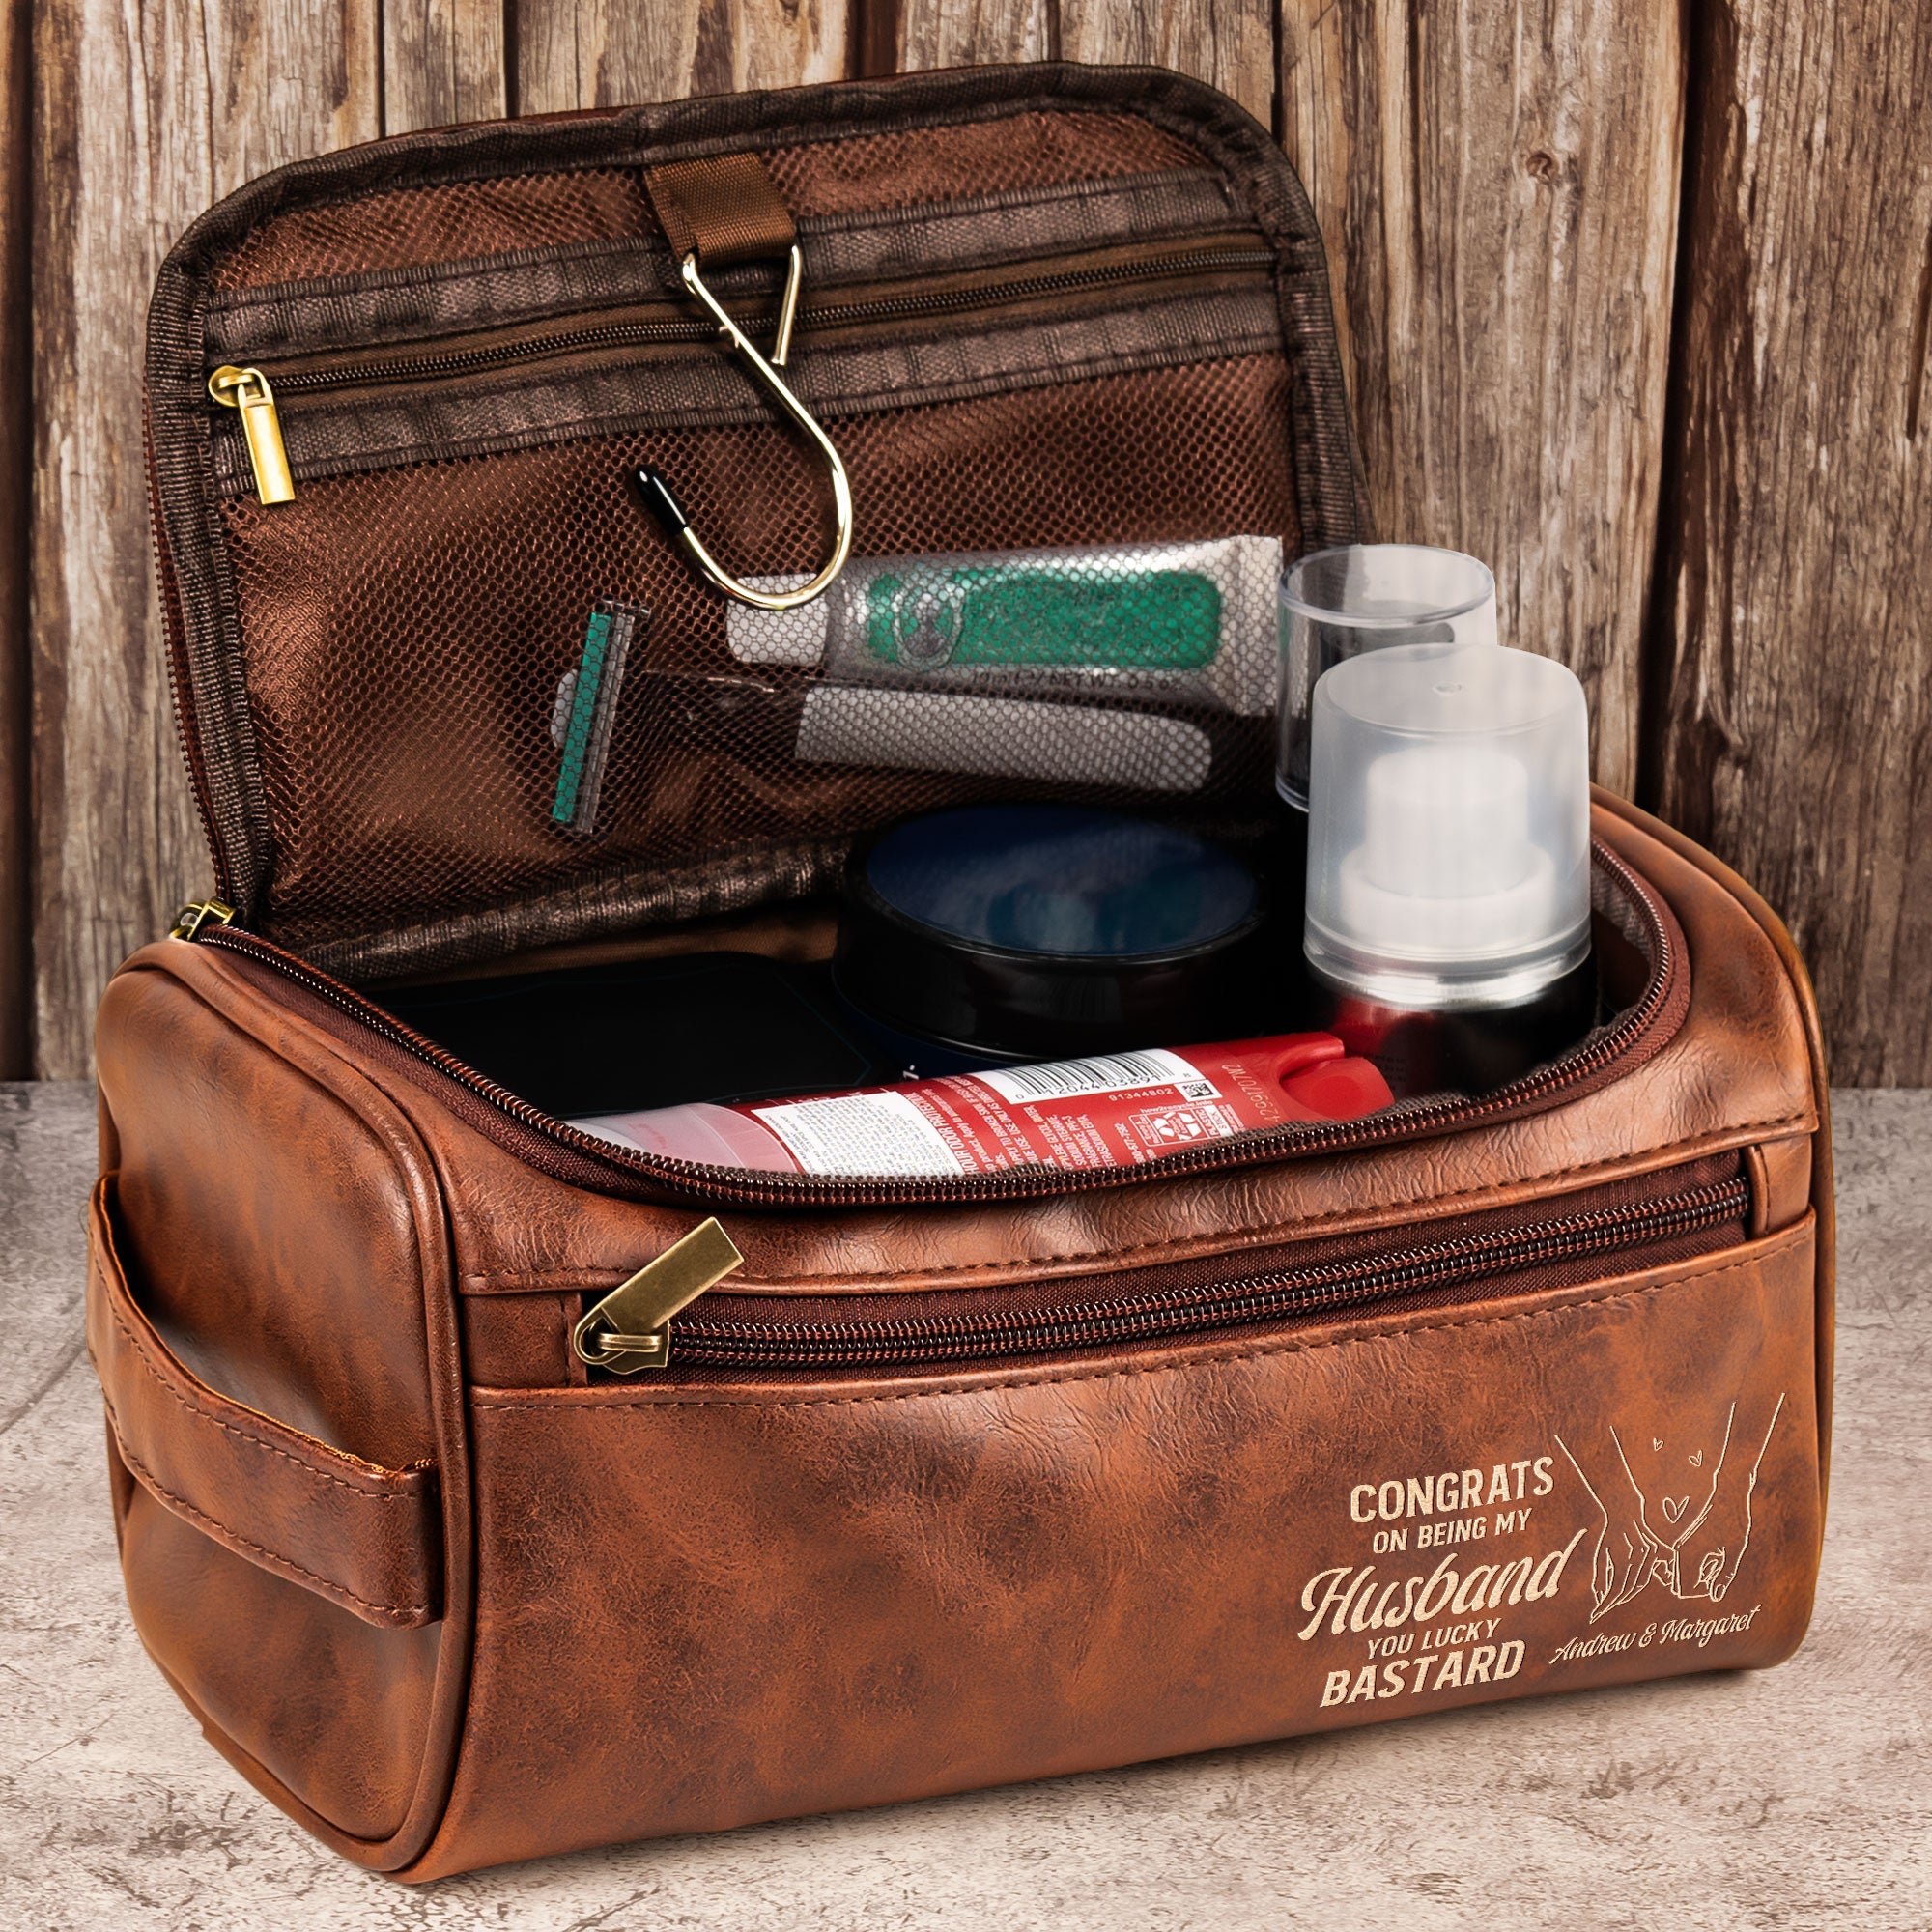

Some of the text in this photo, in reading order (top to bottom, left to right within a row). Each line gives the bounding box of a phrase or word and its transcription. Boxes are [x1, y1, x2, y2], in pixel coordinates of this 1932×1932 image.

[936, 1126, 964, 1150] ODOR
[1196, 1109, 1217, 1135] PLASTIC
[953, 1149, 980, 1174] HOUR
[1350, 1457, 1553, 1523] CONGRATS
[1373, 1507, 1533, 1554] ON BEING MY
[1297, 1528, 1588, 1641] Husband
[1367, 1617, 1503, 1659] YOU LUCKY
[1548, 1605, 1763, 1664] Andrew & Margaret
[1320, 1639, 1526, 1708] BASTARD
